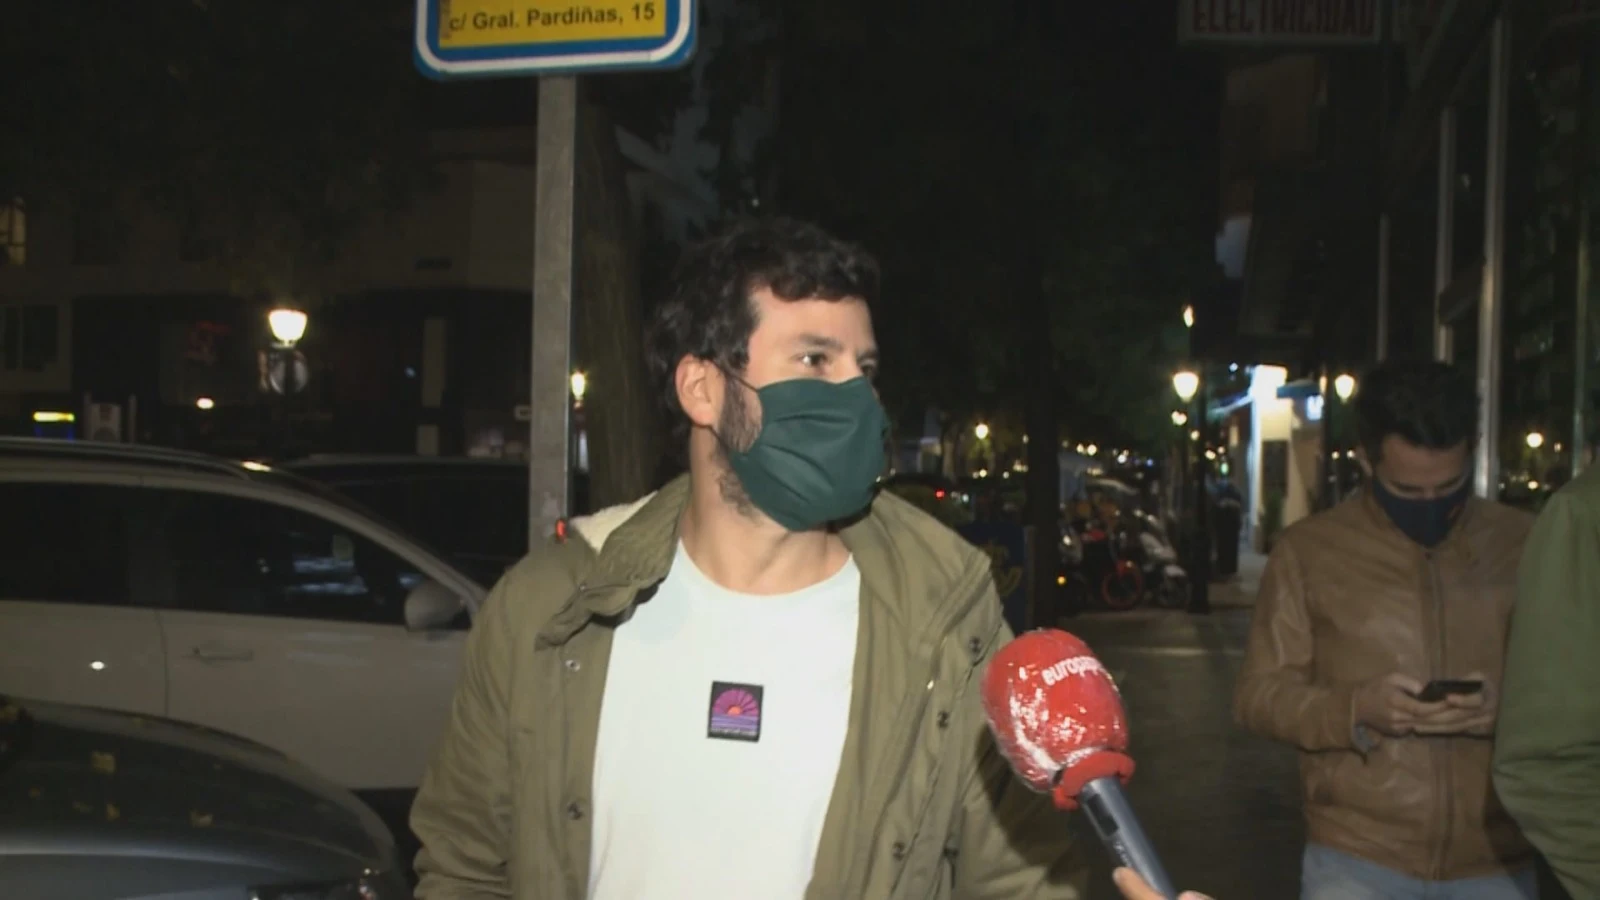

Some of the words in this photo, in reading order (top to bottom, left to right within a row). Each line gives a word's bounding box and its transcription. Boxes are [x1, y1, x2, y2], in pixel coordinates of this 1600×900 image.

[449, 11, 467, 31] c/
[472, 9, 519, 30] Gral.
[527, 2, 624, 27] Pardiñas,
[633, 2, 656, 21] 15
